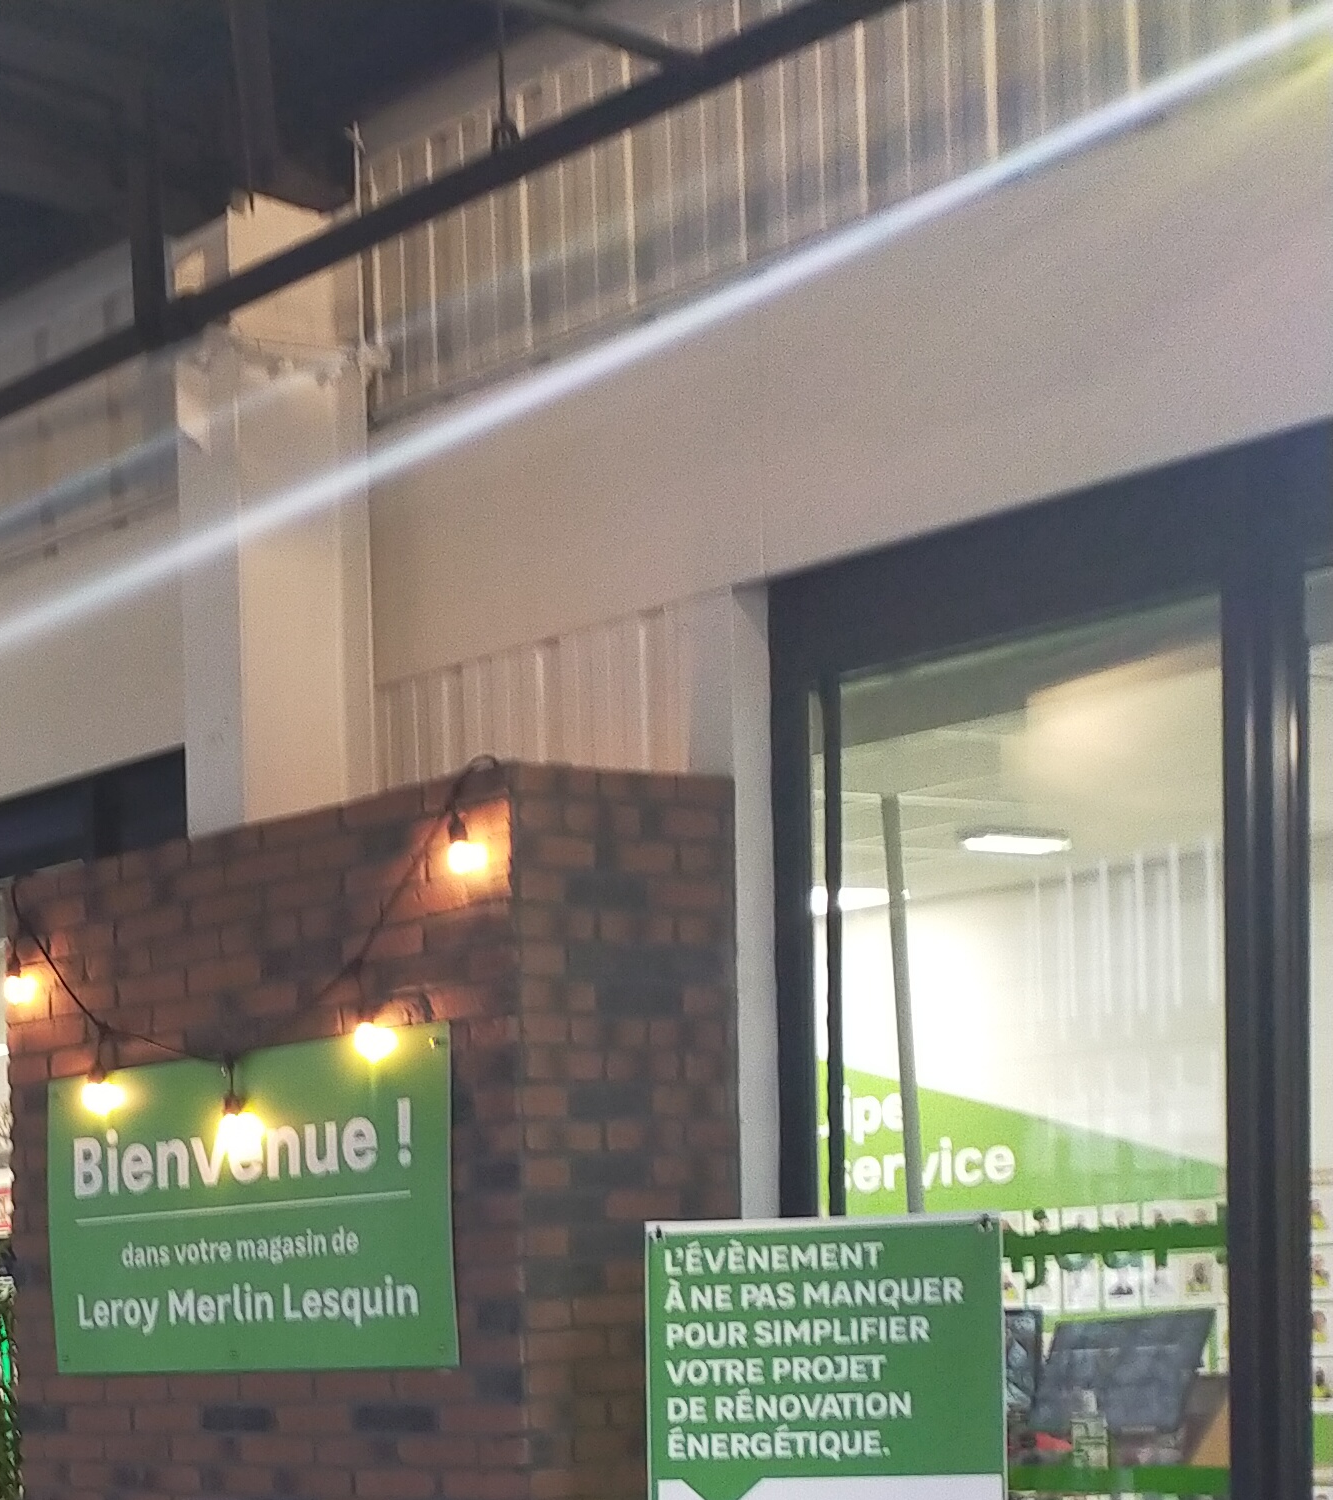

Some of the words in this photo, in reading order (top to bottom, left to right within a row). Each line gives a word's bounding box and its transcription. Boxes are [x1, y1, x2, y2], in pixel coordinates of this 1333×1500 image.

[121, 1242, 171, 1270] dans
[174, 1236, 232, 1266] votre
[236, 1229, 327, 1265] magasin
[331, 1226, 359, 1255] de
[77, 1292, 159, 1335] Leroy
[168, 1282, 274, 1326] Merlin
[283, 1275, 420, 1327] Lesquin
[665, 1278, 685, 1313] À
[690, 1283, 732, 1312] NE
[741, 1282, 796, 1310] PAS
[803, 1276, 963, 1311] MANQUER
[665, 1320, 747, 1350] POUR
[754, 1315, 930, 1347] SIMPLIFIER
[665, 1357, 764, 1386] VOTRE
[773, 1355, 887, 1384] PROJET
[667, 1396, 708, 1424] DE
[715, 1388, 912, 1423] RÉNOVATION
[668, 1426, 890, 1461] ÉNERGÉTIQUE.
